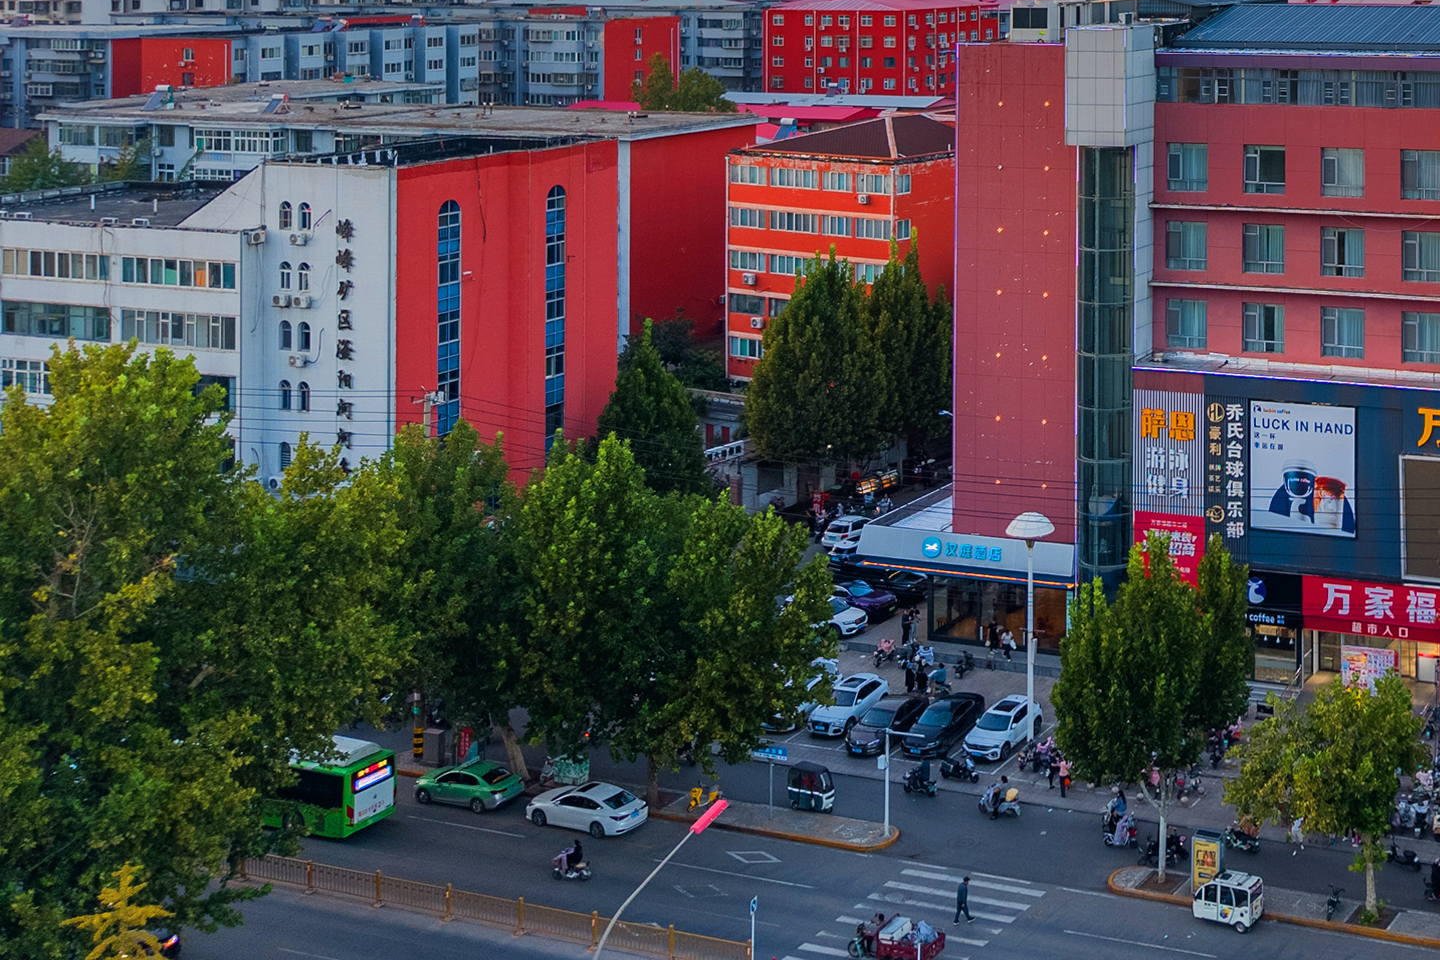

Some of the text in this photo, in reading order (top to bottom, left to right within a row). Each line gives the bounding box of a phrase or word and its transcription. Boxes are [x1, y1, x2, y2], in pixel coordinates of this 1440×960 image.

[1253, 417, 1354, 435] LUCK IN HAND
[1254, 431, 1276, 440] 这一杯
[1209, 425, 1221, 456] 豪利
[1146, 446, 1189, 471] 游泳
[1226, 403, 1244, 539] 乔氏台球俱乐部
[1146, 473, 1189, 499] 健身
[945, 542, 1002, 561] 汉庭酒店
[1322, 583, 1436, 624] 万家福
[1249, 613, 1275, 624] coffee
[1352, 622, 1408, 638] 超市入口
